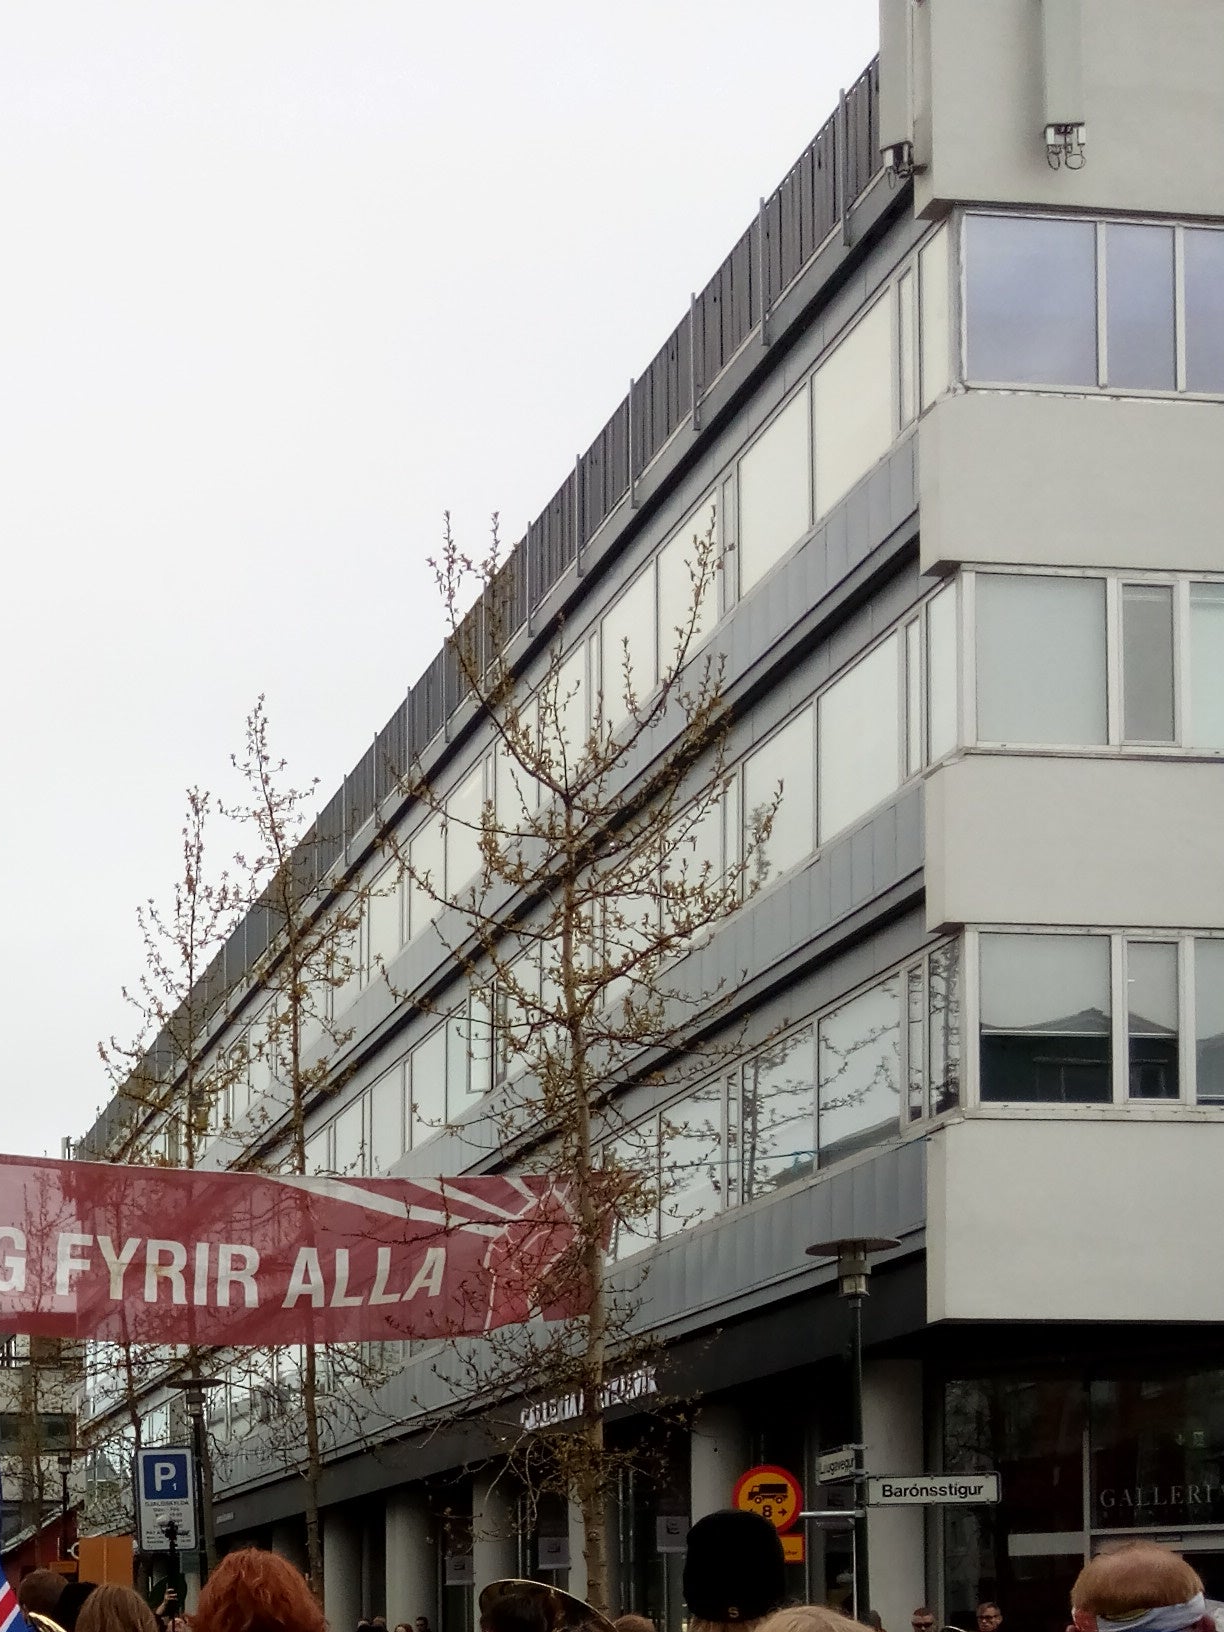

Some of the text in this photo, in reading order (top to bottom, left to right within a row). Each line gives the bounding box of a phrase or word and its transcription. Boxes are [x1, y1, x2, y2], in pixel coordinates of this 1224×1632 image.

[55, 1232, 260, 1308] FYRIR
[281, 1247, 447, 1308] ALLA
[154, 1462, 176, 1492] P
[762, 1504, 773, 1518] 8
